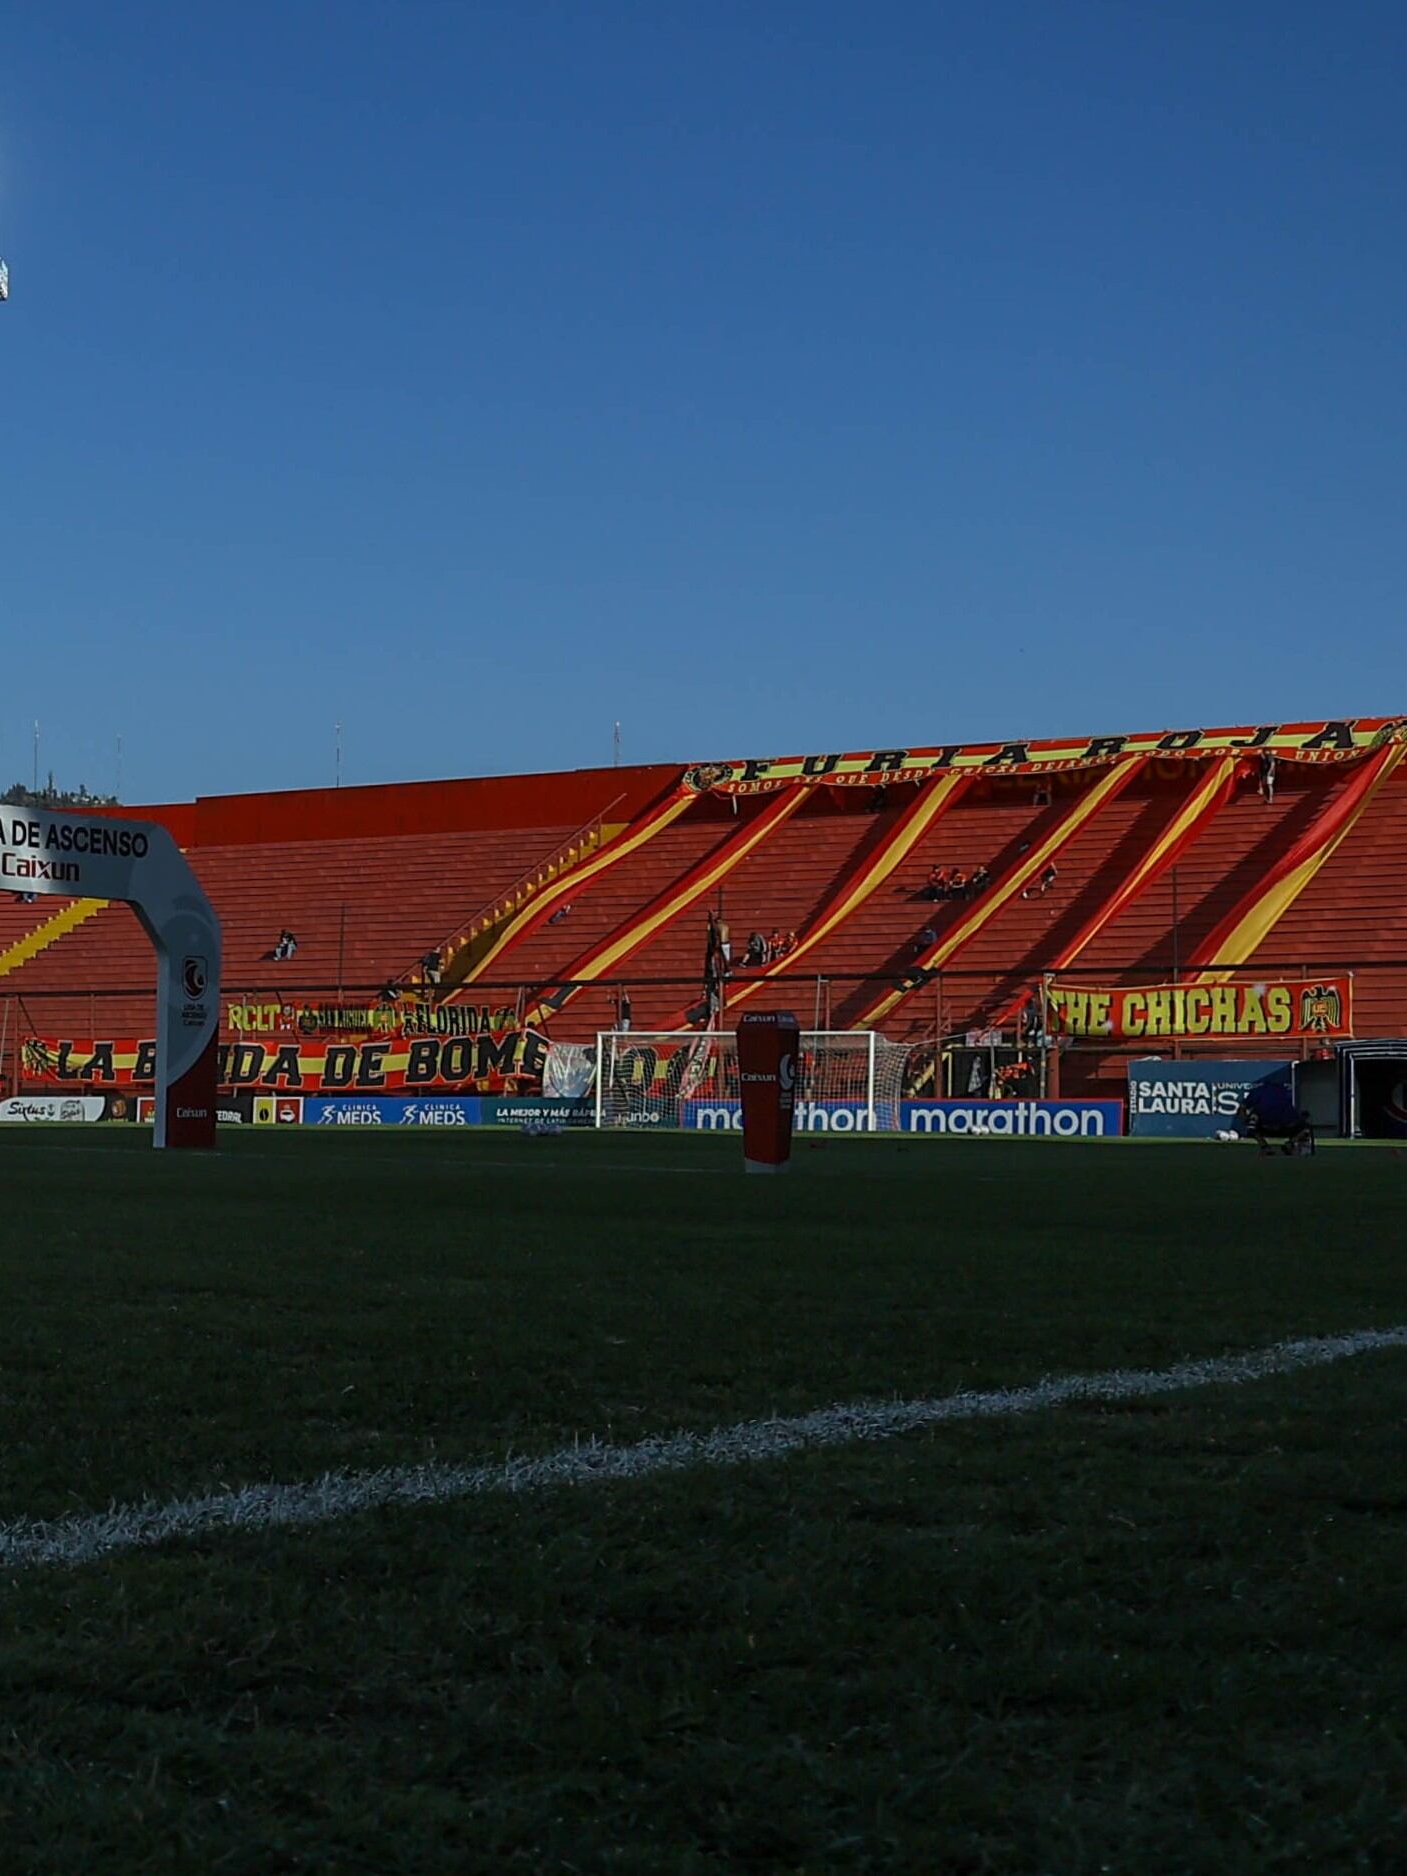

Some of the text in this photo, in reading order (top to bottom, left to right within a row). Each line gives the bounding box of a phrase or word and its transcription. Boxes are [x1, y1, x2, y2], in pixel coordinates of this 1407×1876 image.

[739, 743, 1030, 782] FURIA
[1080, 720, 1359, 759] ROJA
[728, 780, 783, 793] SOMOS
[836, 773, 868, 784] QUE
[881, 769, 935, 783] DESDE
[12, 820, 41, 849] DE
[45, 823, 149, 859] ASCENSO
[1, 852, 80, 882] Caixun
[1050, 987, 1291, 1036] THE CHICHAS
[58, 1039, 116, 1082] LA
[320, 1041, 392, 1089] DE
[1139, 1081, 1210, 1098] SANTA
[337, 1111, 381, 1125] MEDS
[419, 1111, 466, 1126] MEDS
[496, 1108, 508, 1117] LA
[510, 1108, 542, 1117] MEJOR
[542, 1108, 550, 1117] Y
[550, 1107, 570, 1118] MÁS
[910, 1102, 1104, 1136] marathon
[1138, 1098, 1211, 1115] LAURA
